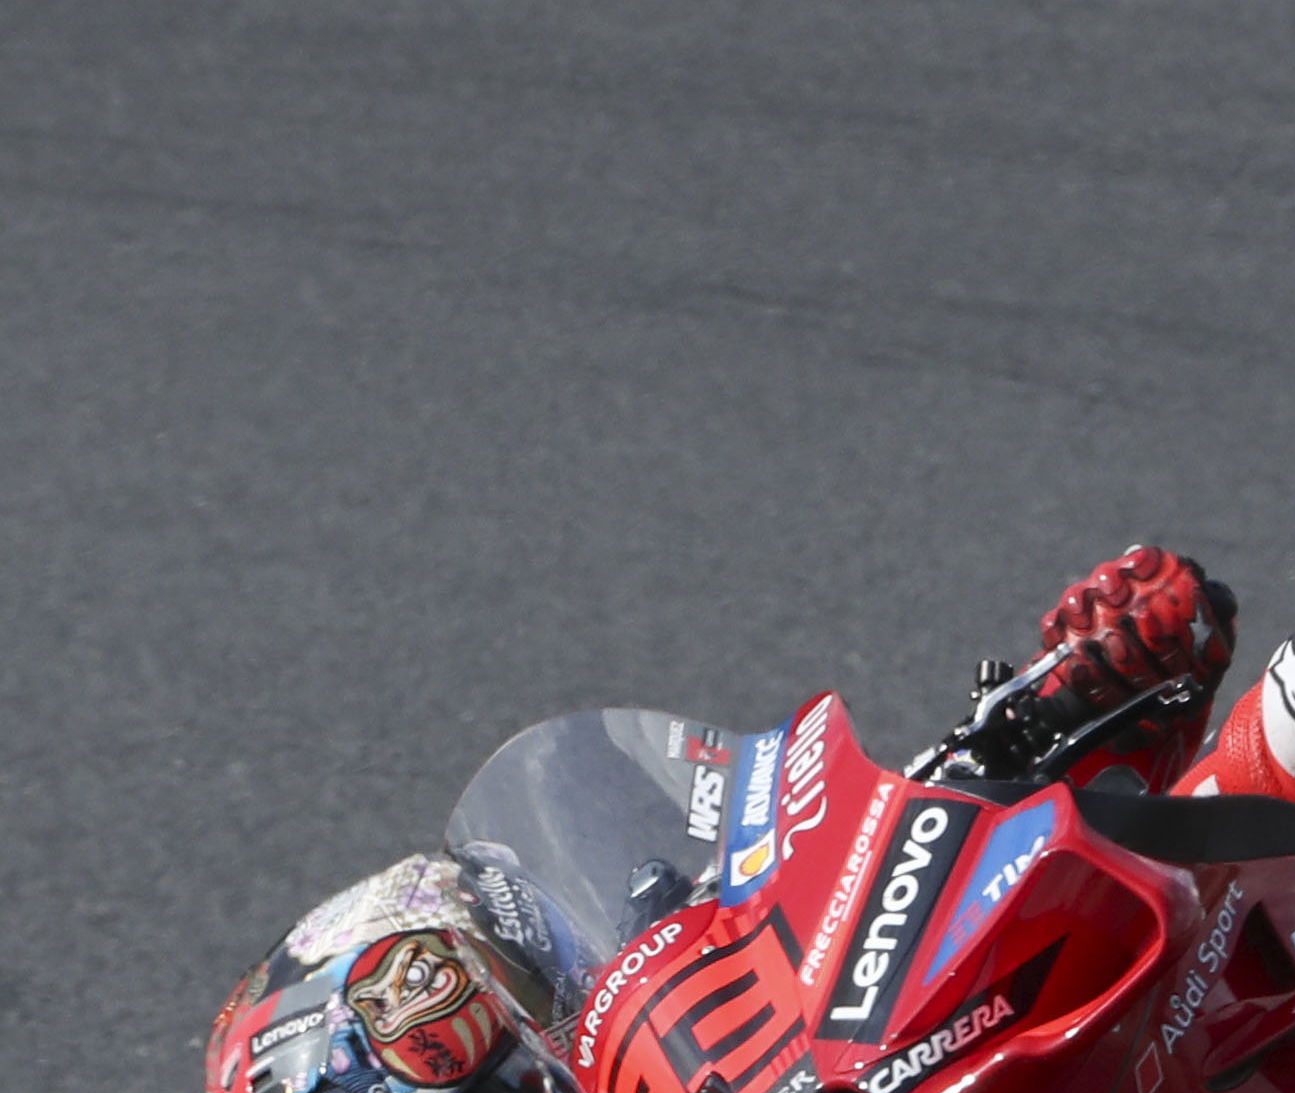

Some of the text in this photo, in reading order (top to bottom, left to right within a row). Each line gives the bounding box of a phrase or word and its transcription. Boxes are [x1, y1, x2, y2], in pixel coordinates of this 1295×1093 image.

[800, 782, 897, 987] FRECCIAROSSA
[829, 806, 949, 1021] Lenovo
[982, 835, 1047, 902] TIM
[251, 1012, 325, 1054] Lenovo
[577, 921, 683, 1069] VARGROUP
[1160, 879, 1244, 1055] Audi Sport
